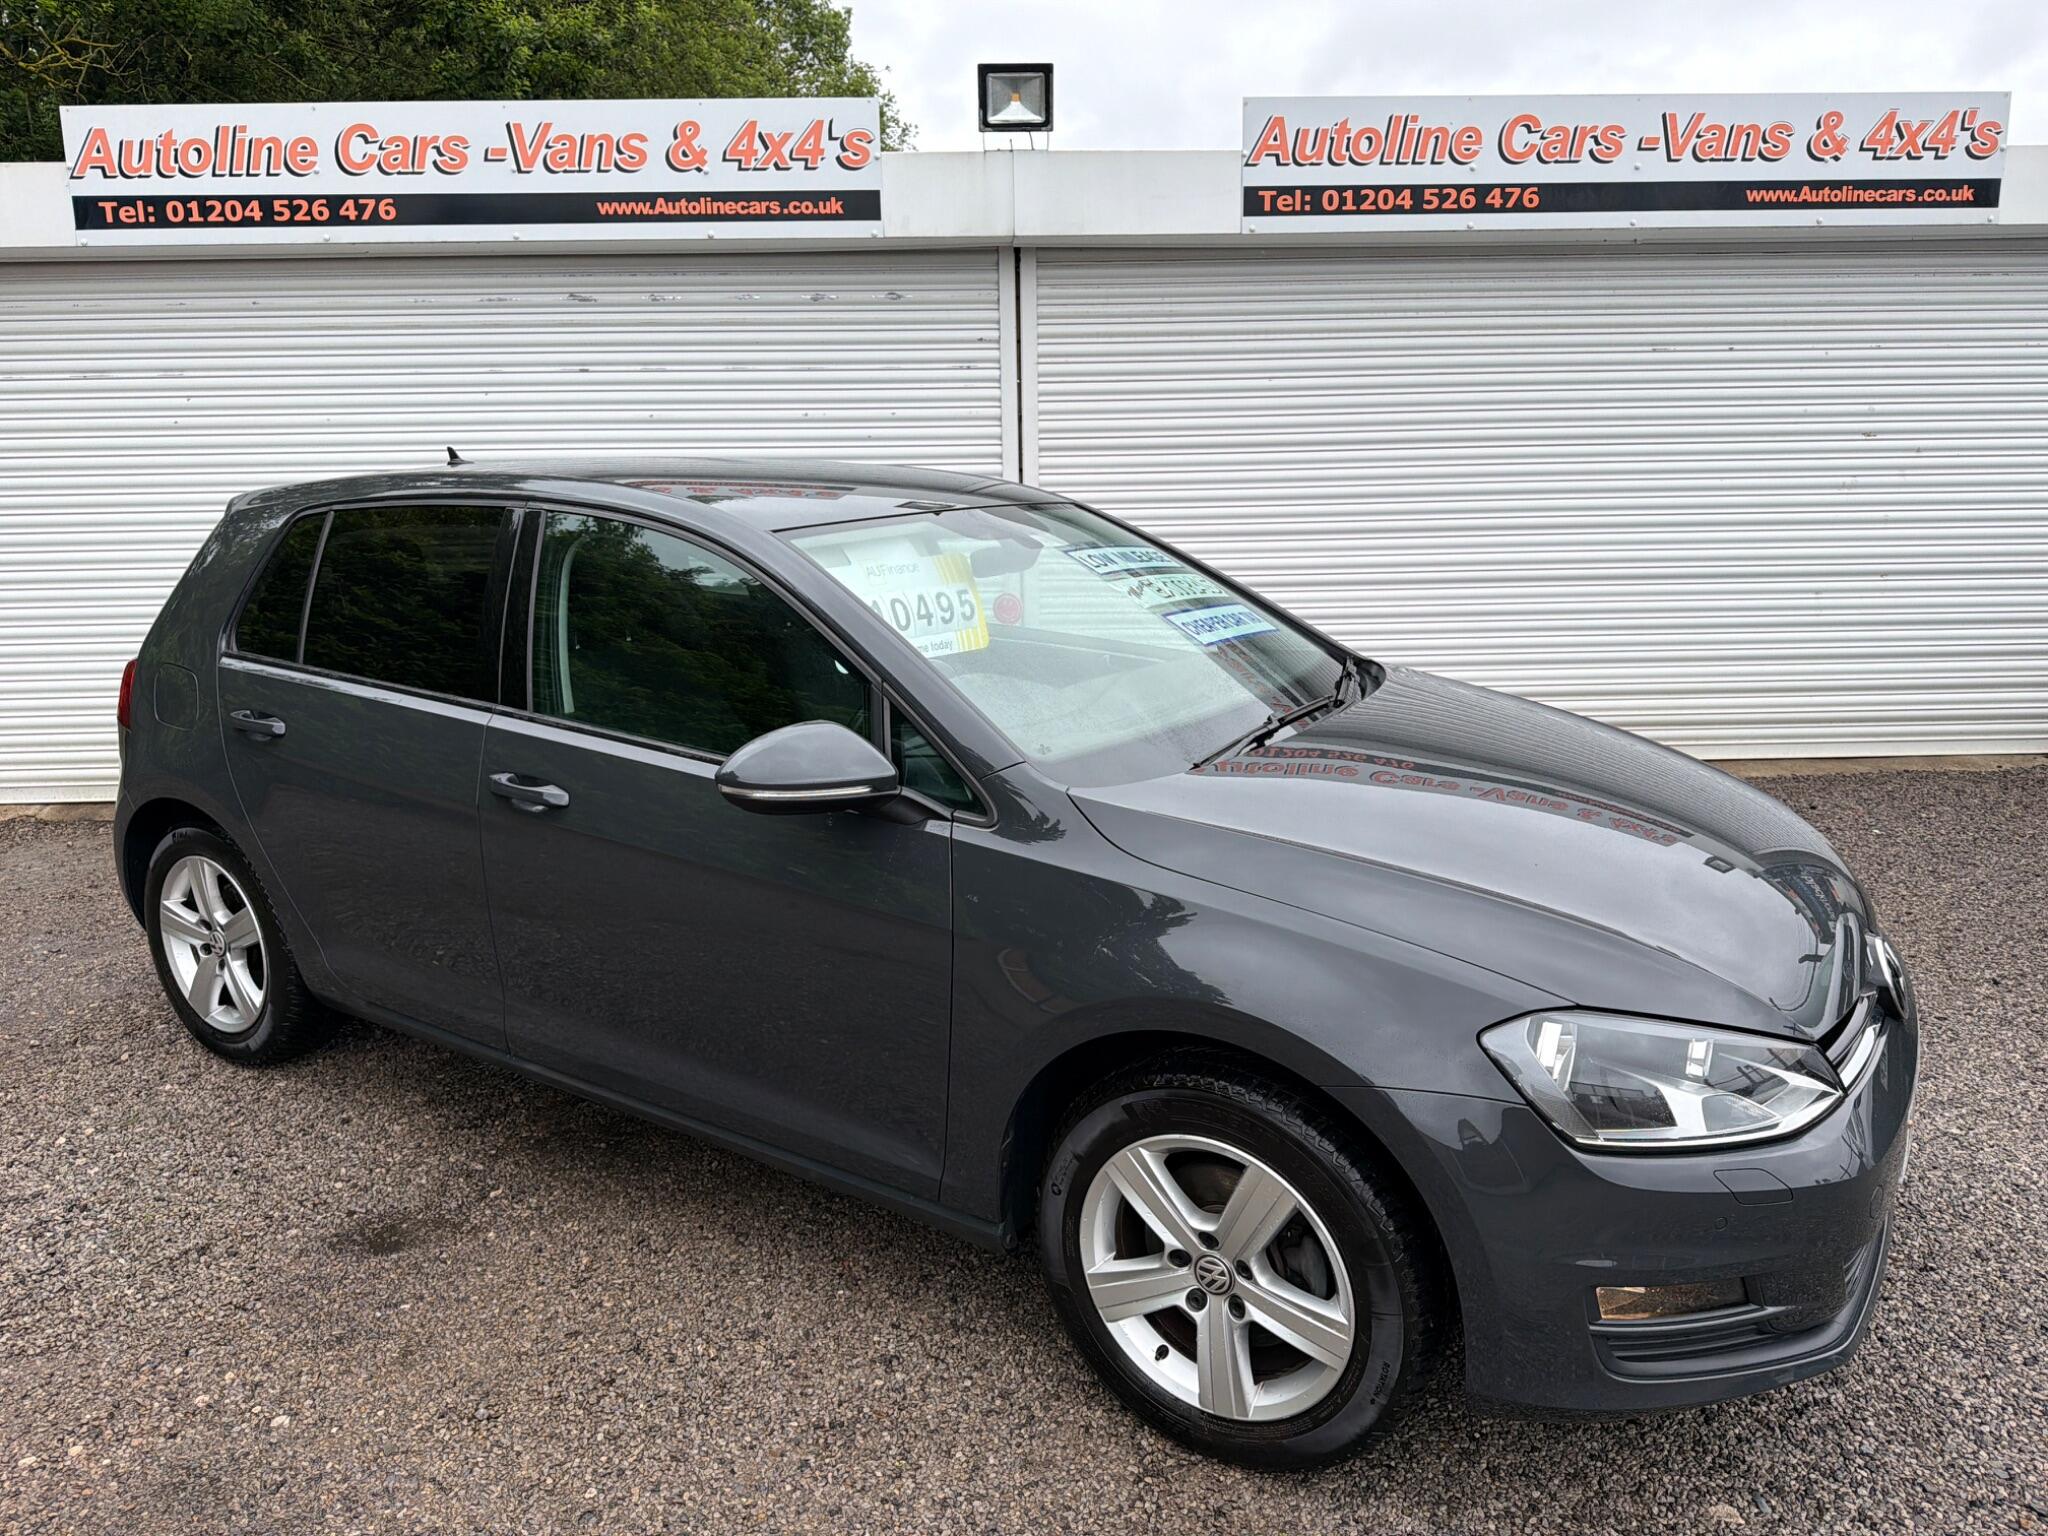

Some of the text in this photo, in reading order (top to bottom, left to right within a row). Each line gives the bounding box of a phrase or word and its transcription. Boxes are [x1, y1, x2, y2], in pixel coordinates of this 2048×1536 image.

[69, 124, 319, 180] Autoline
[334, 122, 472, 176] Cars
[665, 118, 709, 173] &
[721, 117, 876, 173] 4x4's
[1244, 113, 1484, 167] Autoline
[1499, 113, 1628, 164] Cars
[1806, 110, 1849, 161] &
[1858, 107, 2004, 160] 4x4's
[596, 196, 844, 216] www.Autolinecars.co.uk
[1258, 186, 1540, 212] Tel: 01204 526 476
[1746, 184, 1975, 204] www.Autolinecars.co.uk
[98, 197, 397, 224] Tel: 01204 526 476
